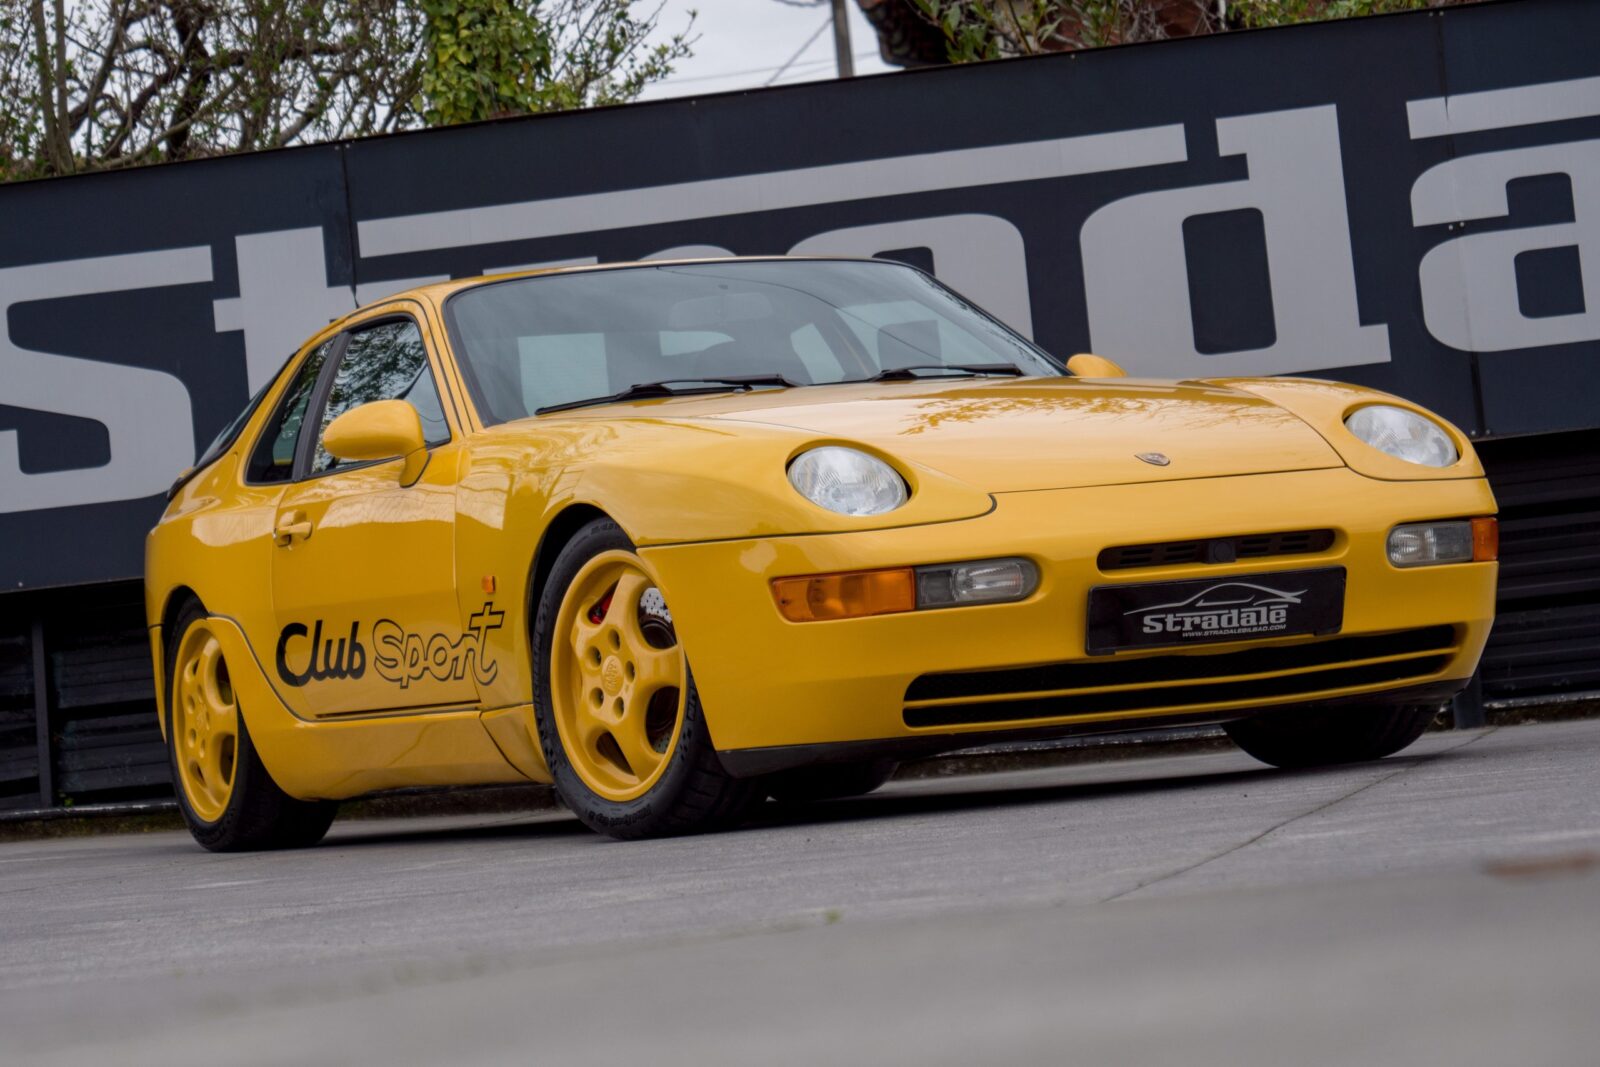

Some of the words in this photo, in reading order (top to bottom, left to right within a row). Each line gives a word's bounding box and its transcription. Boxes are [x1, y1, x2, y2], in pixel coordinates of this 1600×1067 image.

[276, 620, 367, 687] Club
[373, 601, 505, 689] Sport
[1142, 604, 1289, 634] Stradale
